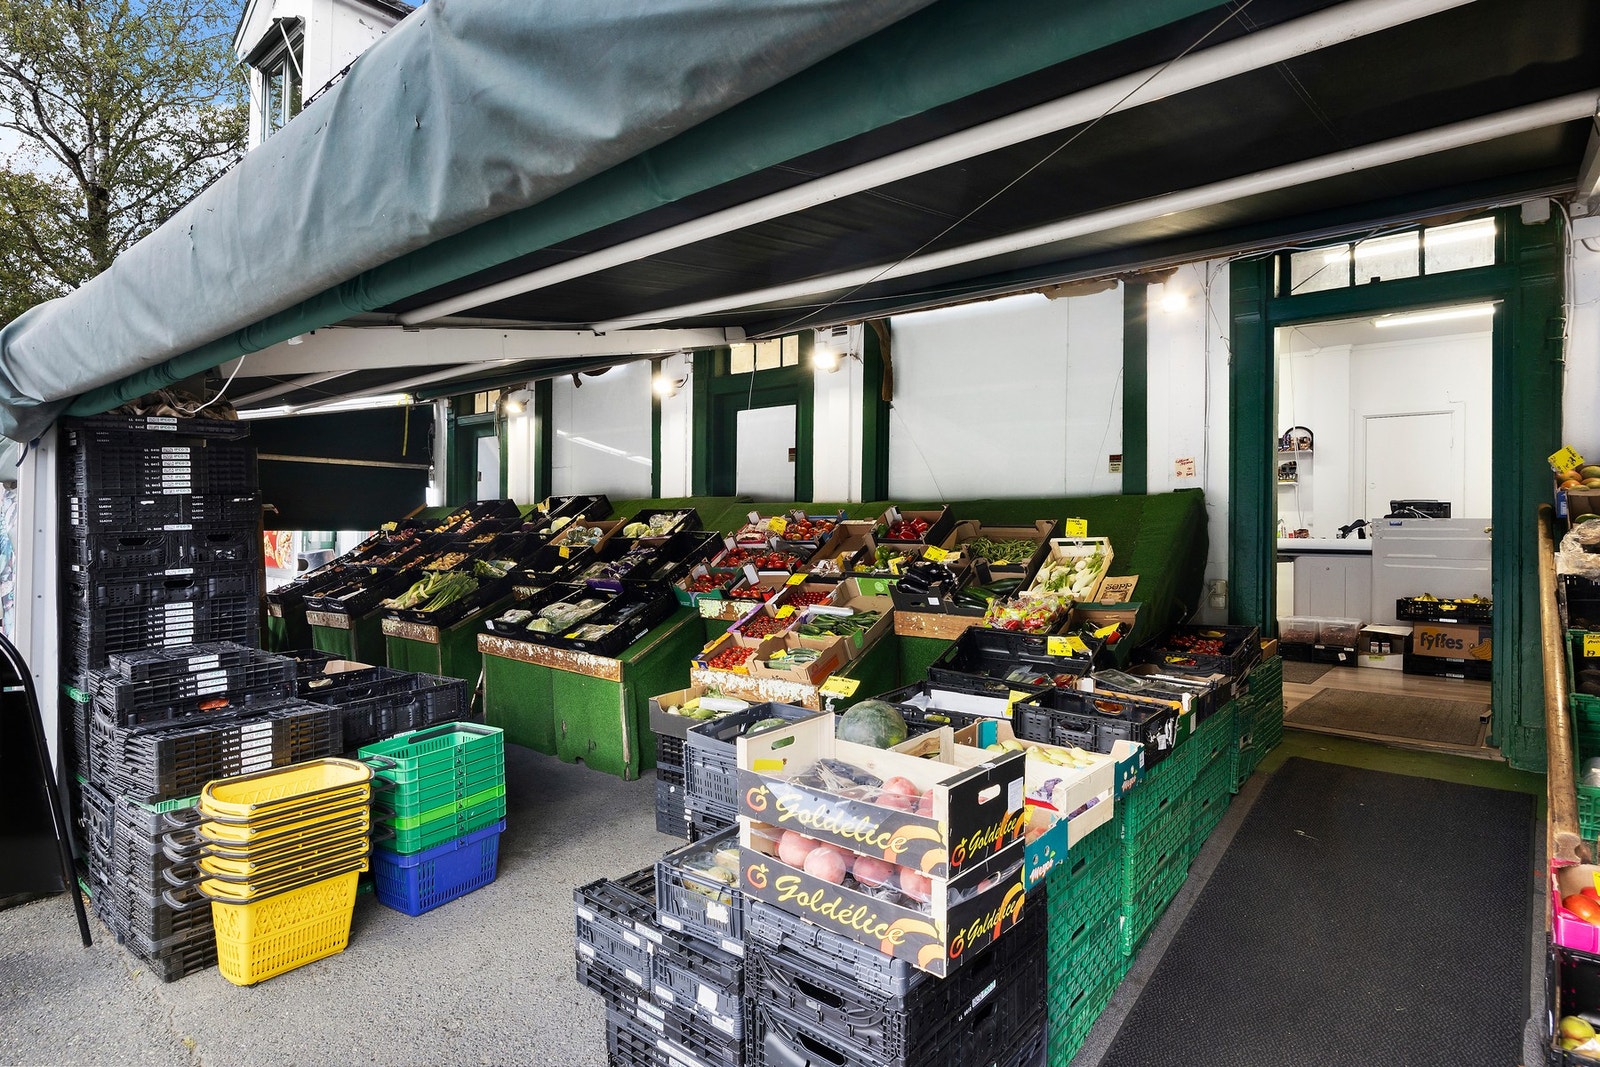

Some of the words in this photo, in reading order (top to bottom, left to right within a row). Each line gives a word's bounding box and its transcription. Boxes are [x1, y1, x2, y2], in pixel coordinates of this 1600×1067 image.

[1420, 631, 1464, 651] fyffes
[776, 793, 909, 854] Goldélice
[968, 817, 1018, 859] Goldélice
[775, 875, 906, 946] Goldélice
[967, 899, 1016, 949] Goldélice
